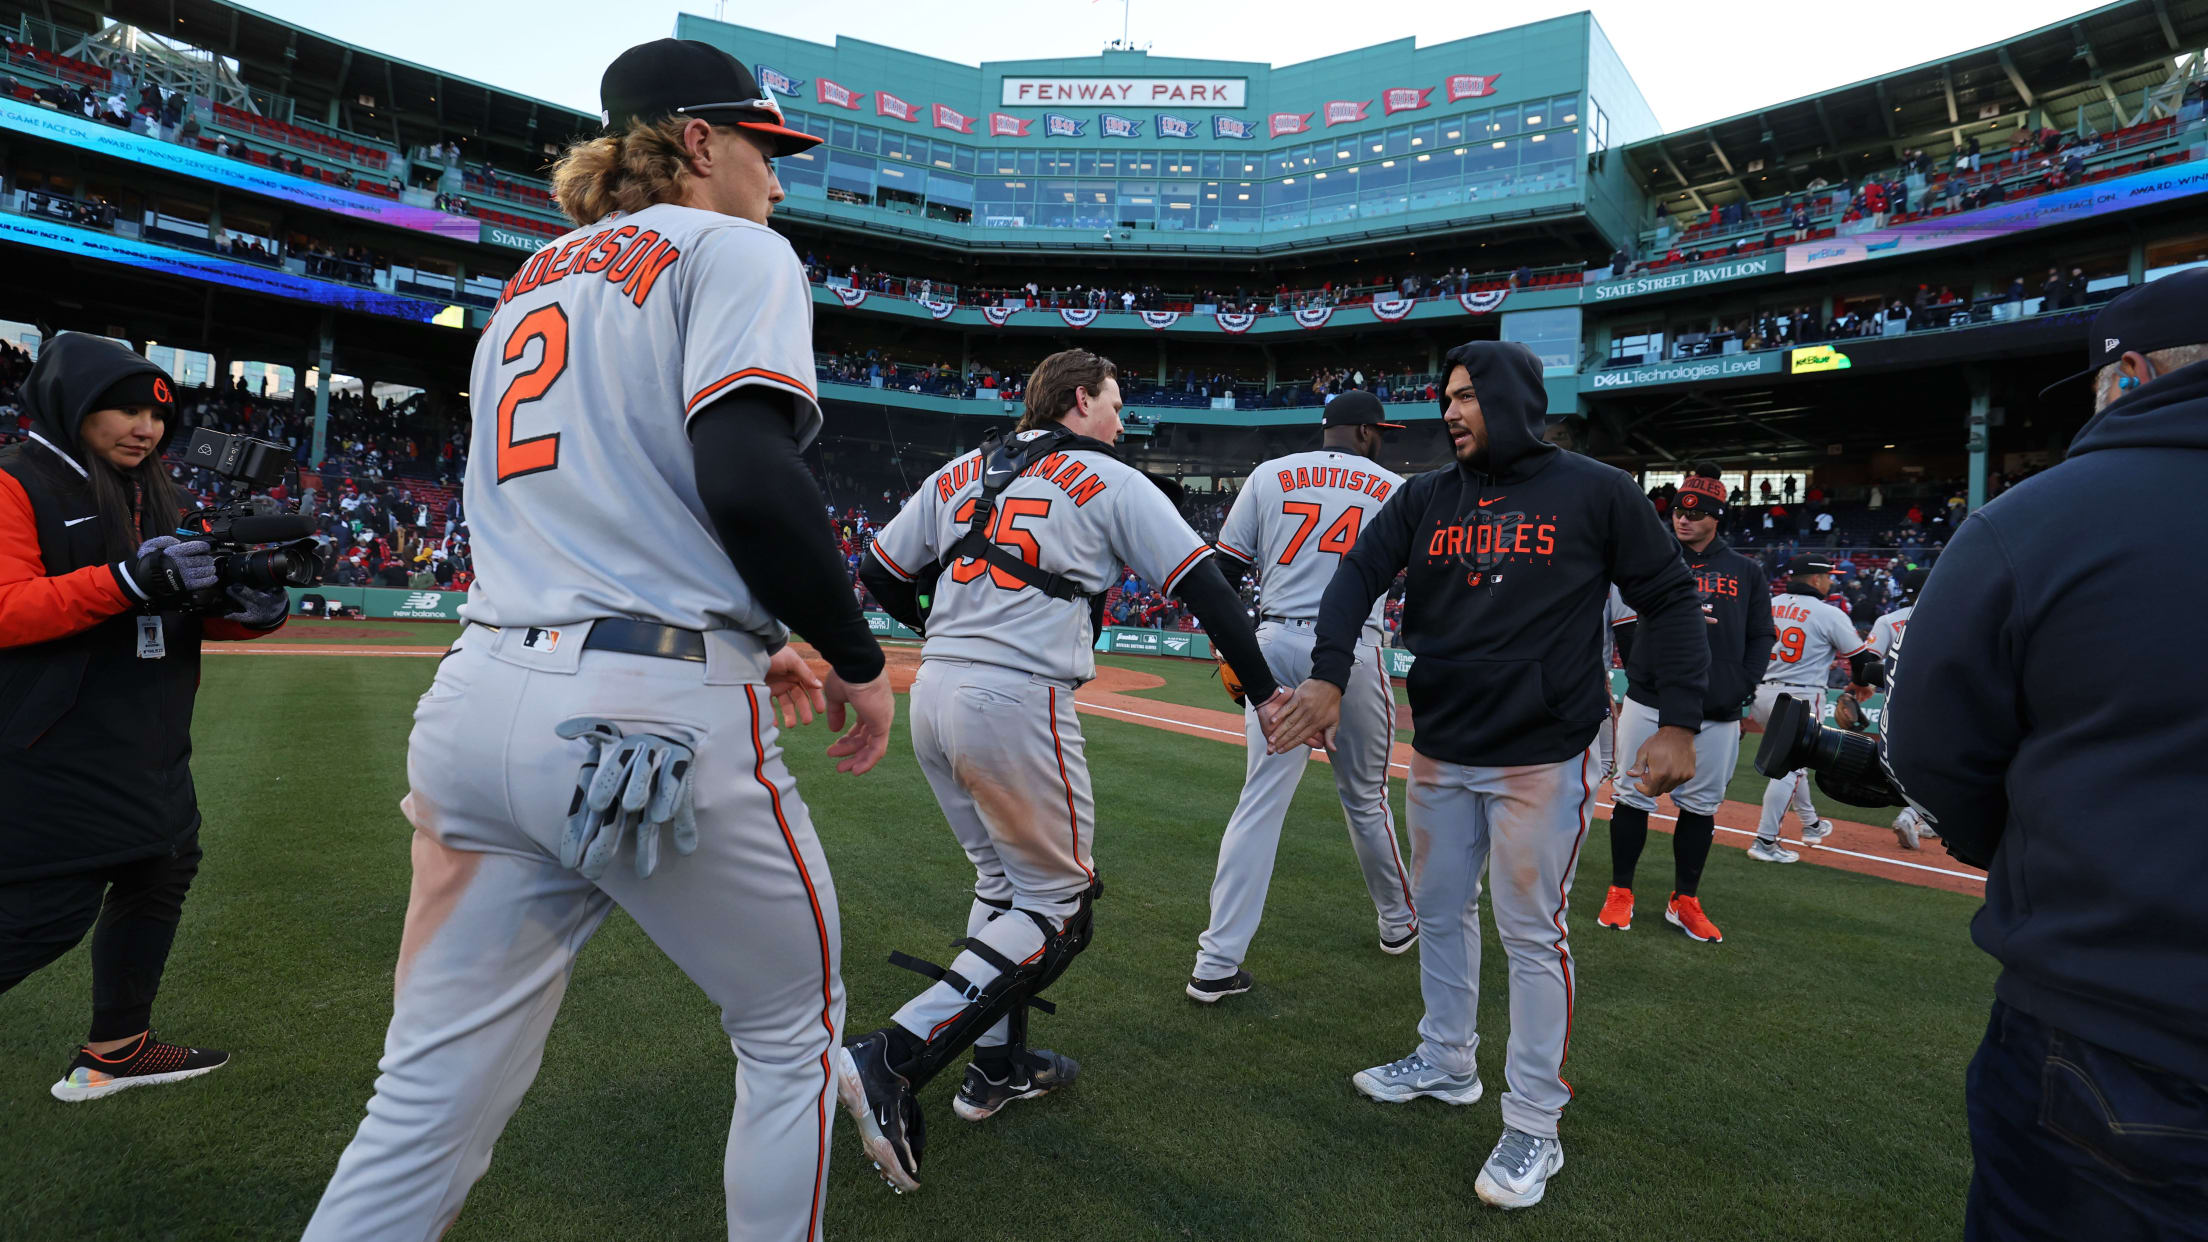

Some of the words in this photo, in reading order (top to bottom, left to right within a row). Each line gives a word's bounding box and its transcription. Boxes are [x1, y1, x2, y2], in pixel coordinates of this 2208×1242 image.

[1018, 84, 1133, 100] FENWAY
[1152, 84, 1227, 100] PARK
[491, 229, 533, 250] STATE
[482, 225, 681, 336] NDERSON
[1596, 282, 1635, 299] STATE
[1638, 273, 1688, 293] STREET
[1692, 260, 1767, 284] PAVILION
[1594, 373, 1632, 387] DELL
[1632, 362, 1719, 382] Technologies
[1723, 357, 1760, 374] Level
[497, 301, 569, 486] 2
[937, 451, 1107, 508] RUTHMAN
[1278, 466, 1392, 504] BAUTISTA
[1277, 501, 1364, 567] 74
[1428, 523, 1556, 556] ORIOLES
[166, 568, 180, 591] Canon
